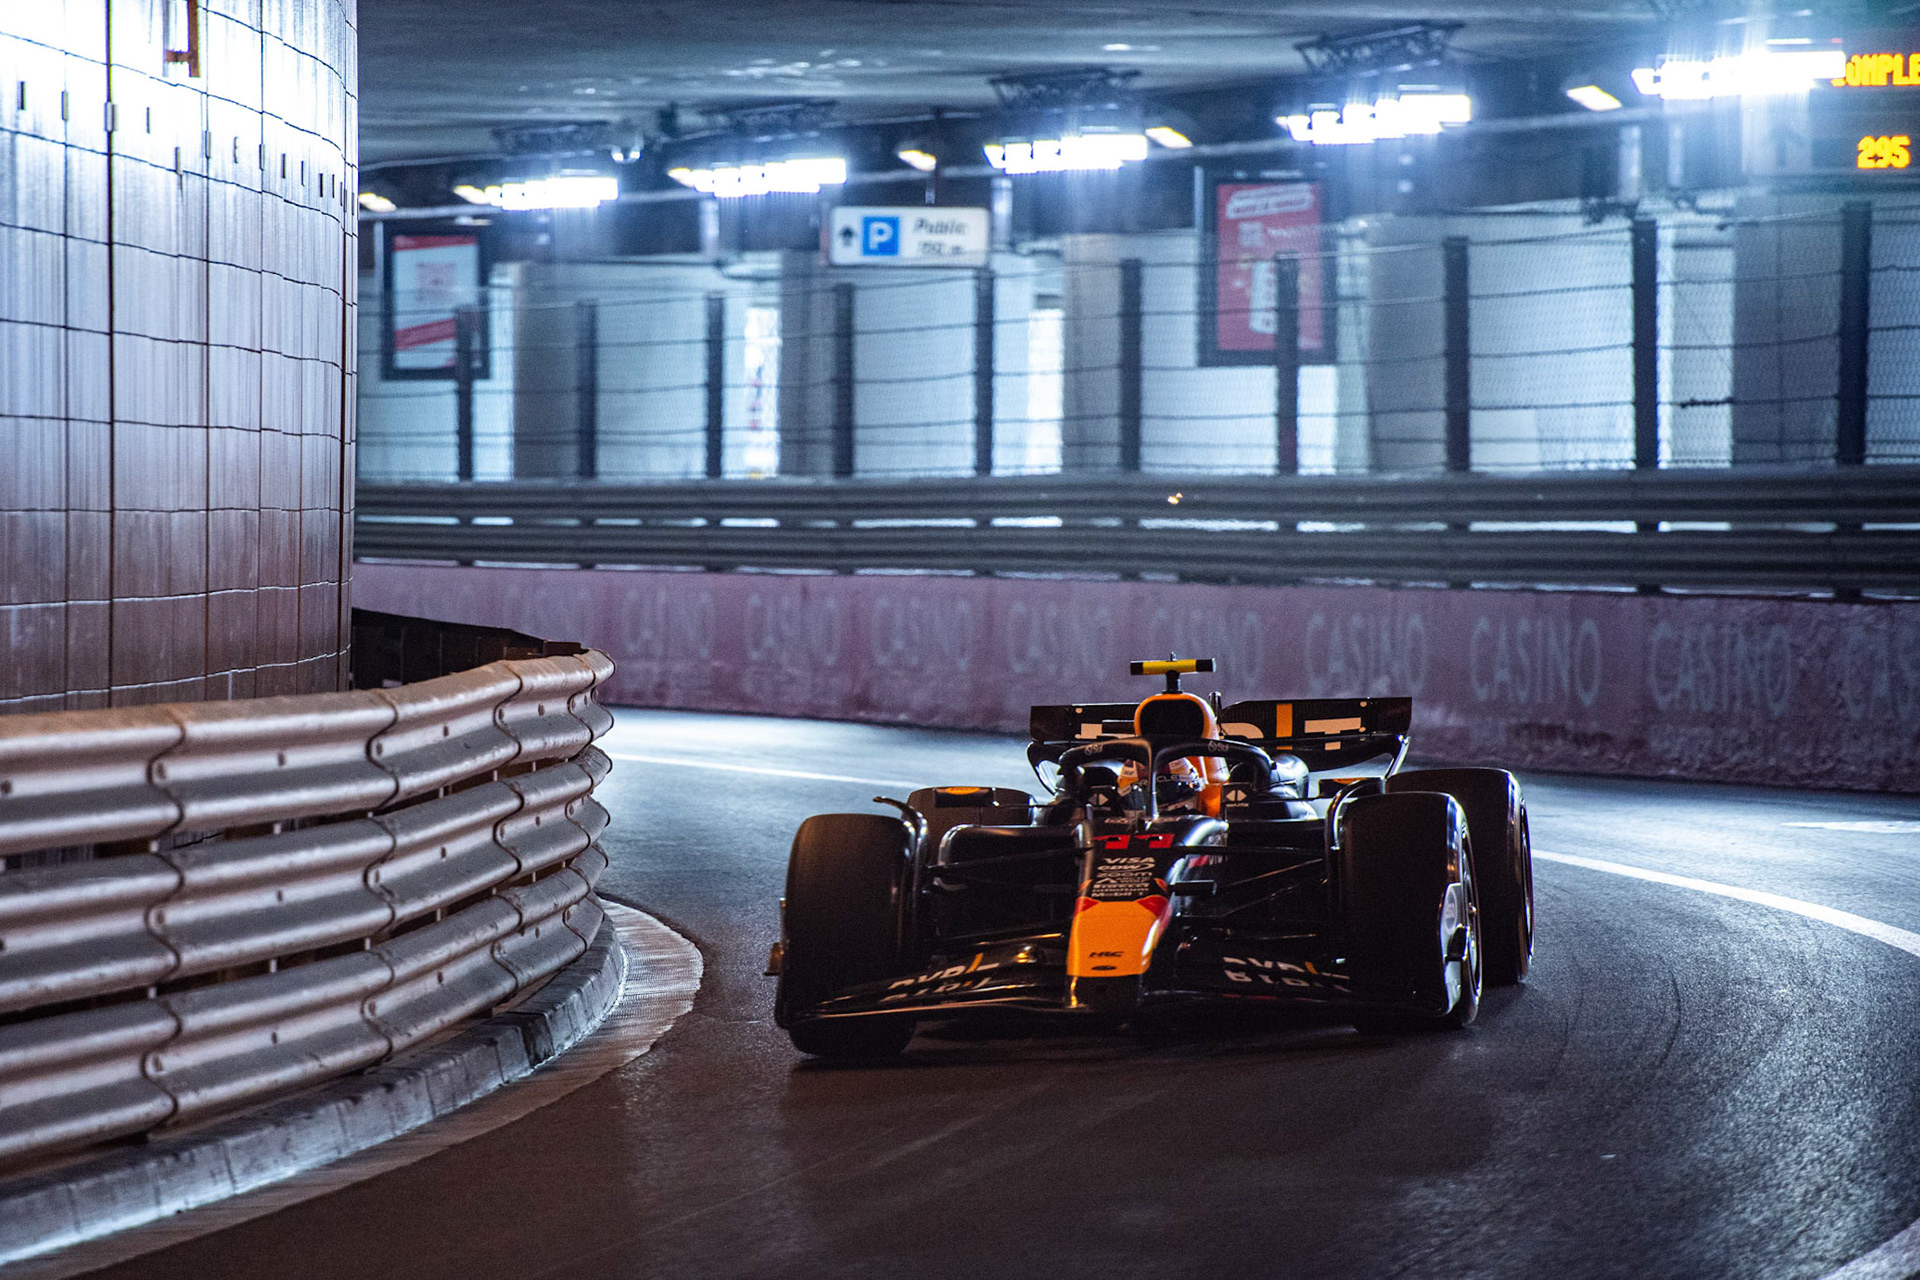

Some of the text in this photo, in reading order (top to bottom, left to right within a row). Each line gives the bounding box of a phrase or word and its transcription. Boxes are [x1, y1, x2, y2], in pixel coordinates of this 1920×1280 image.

[1857, 135, 1911, 168] 295
[869, 221, 893, 250] P
[1469, 614, 1601, 707] CASINO
[1650, 619, 1791, 717] CASINO
